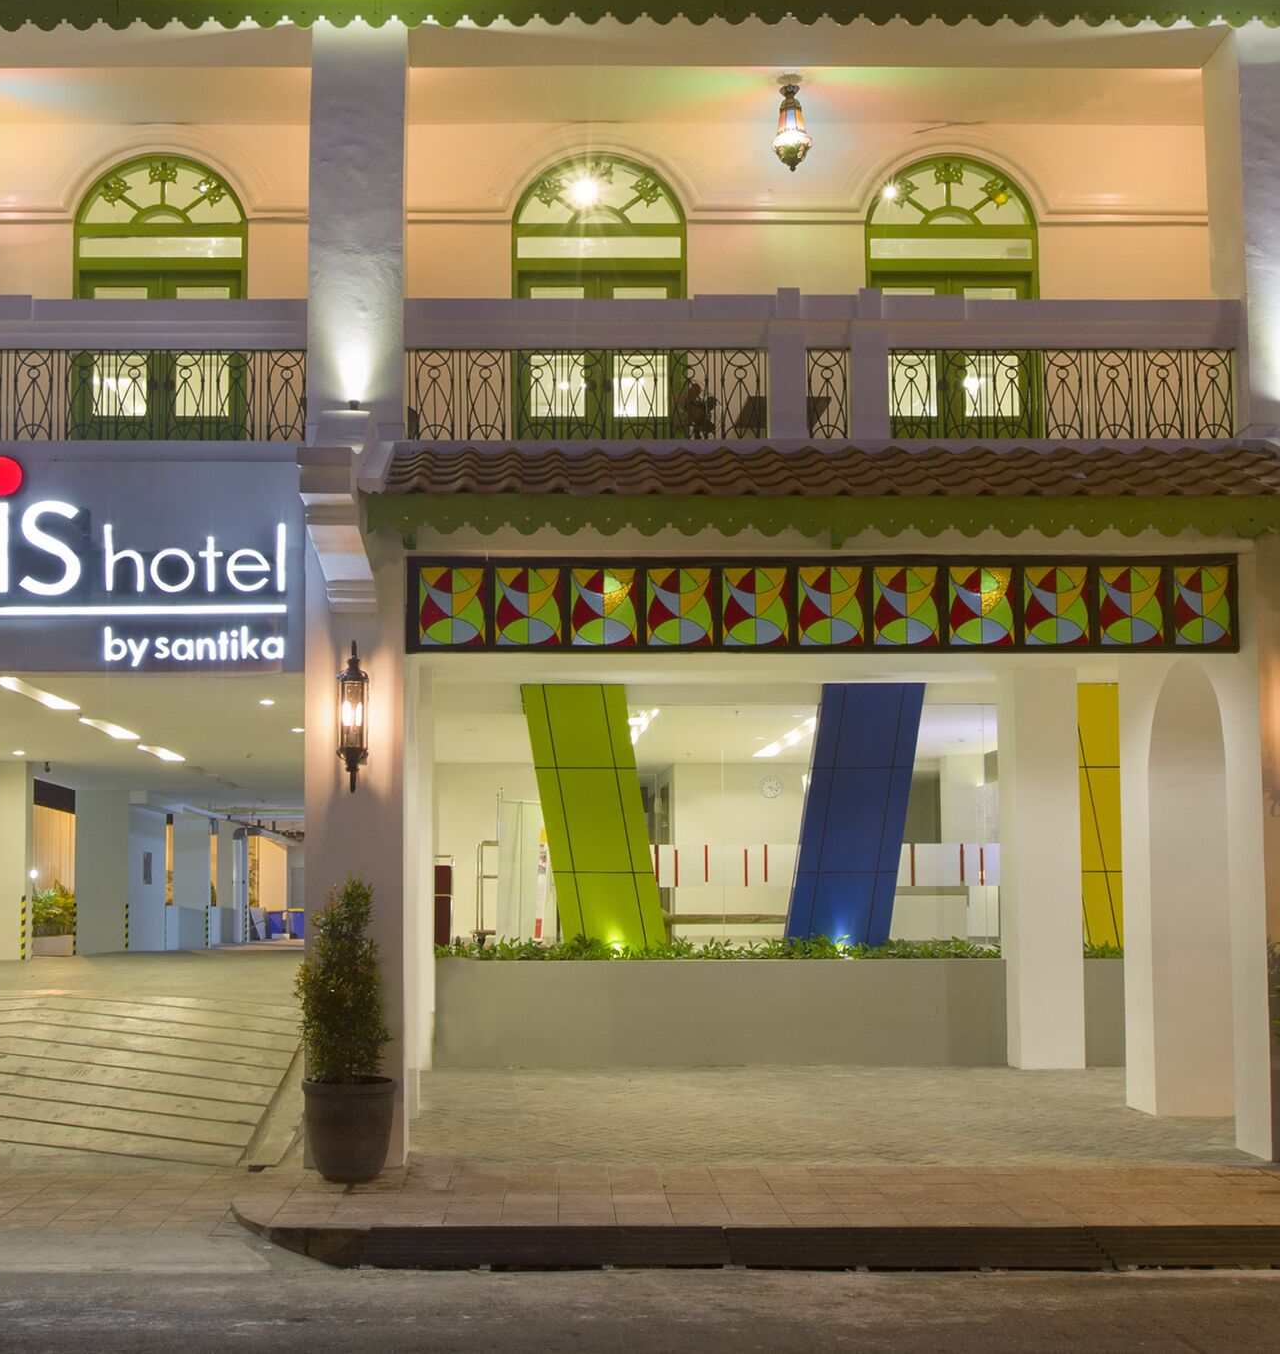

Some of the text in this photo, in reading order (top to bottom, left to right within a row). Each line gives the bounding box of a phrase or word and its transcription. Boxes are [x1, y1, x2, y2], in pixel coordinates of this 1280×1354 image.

[103, 523, 286, 593] hotel
[104, 625, 284, 667] by santika
